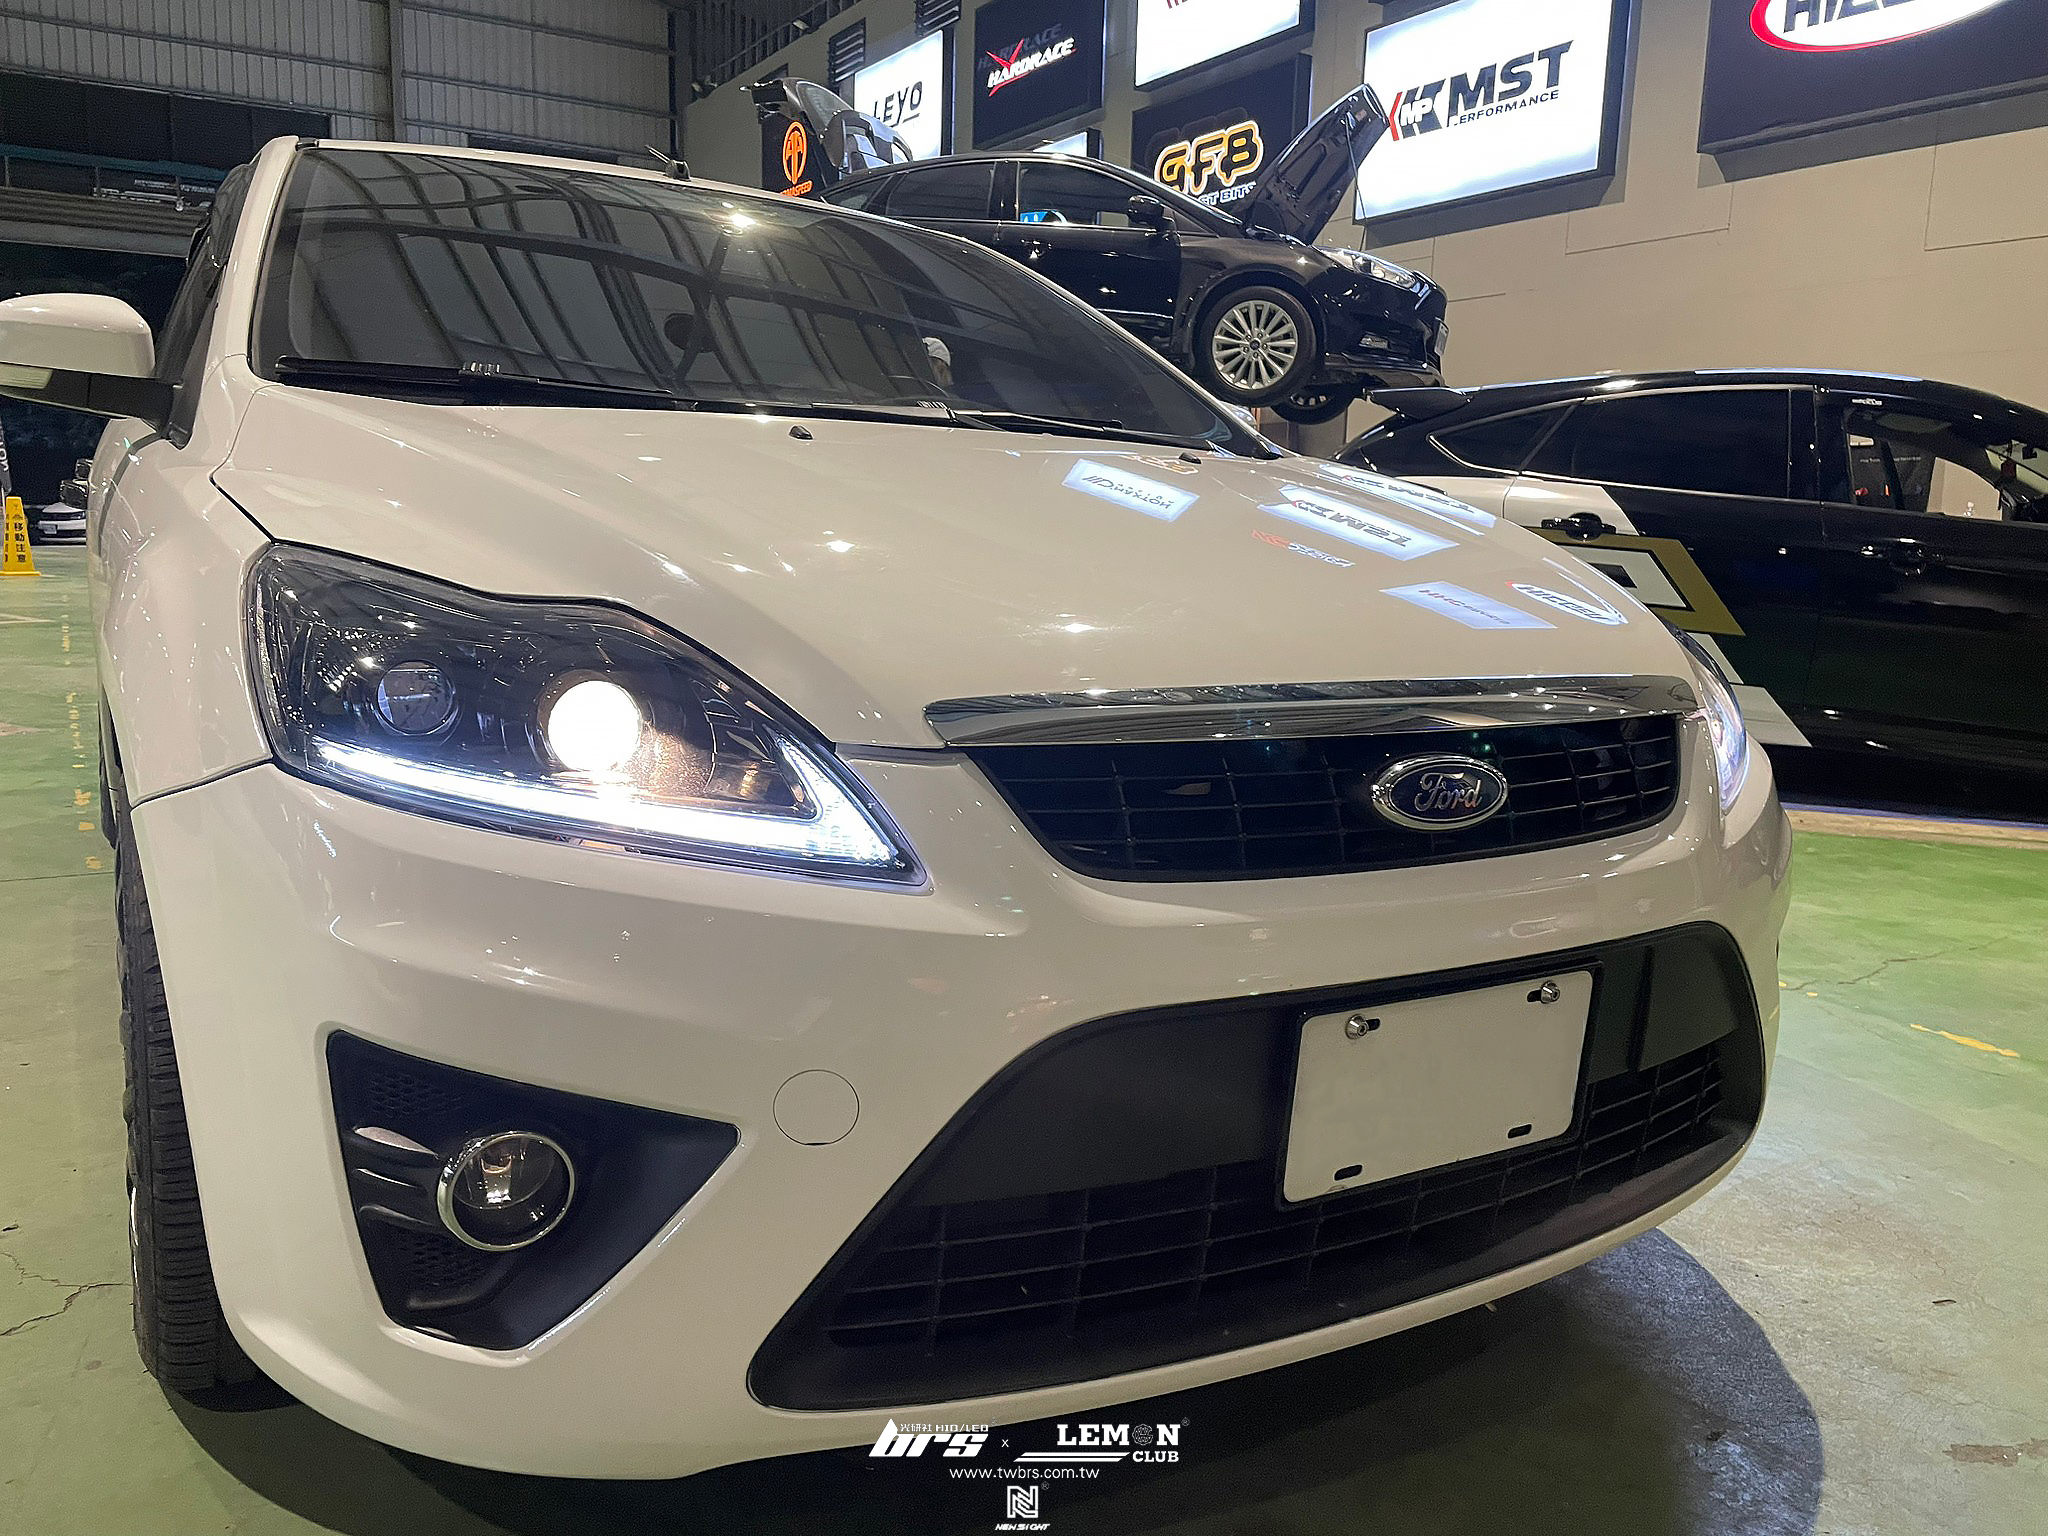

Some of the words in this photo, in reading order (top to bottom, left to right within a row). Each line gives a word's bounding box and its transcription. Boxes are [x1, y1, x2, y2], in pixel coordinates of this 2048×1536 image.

[987, 37, 1075, 88] HARDRACE
[1446, 40, 1574, 127] MST
[873, 81, 922, 128] LEYO
[1454, 90, 1559, 126] ERFORMANCE
[1154, 120, 1264, 196] GFB
[1414, 772, 1482, 811] Ford
